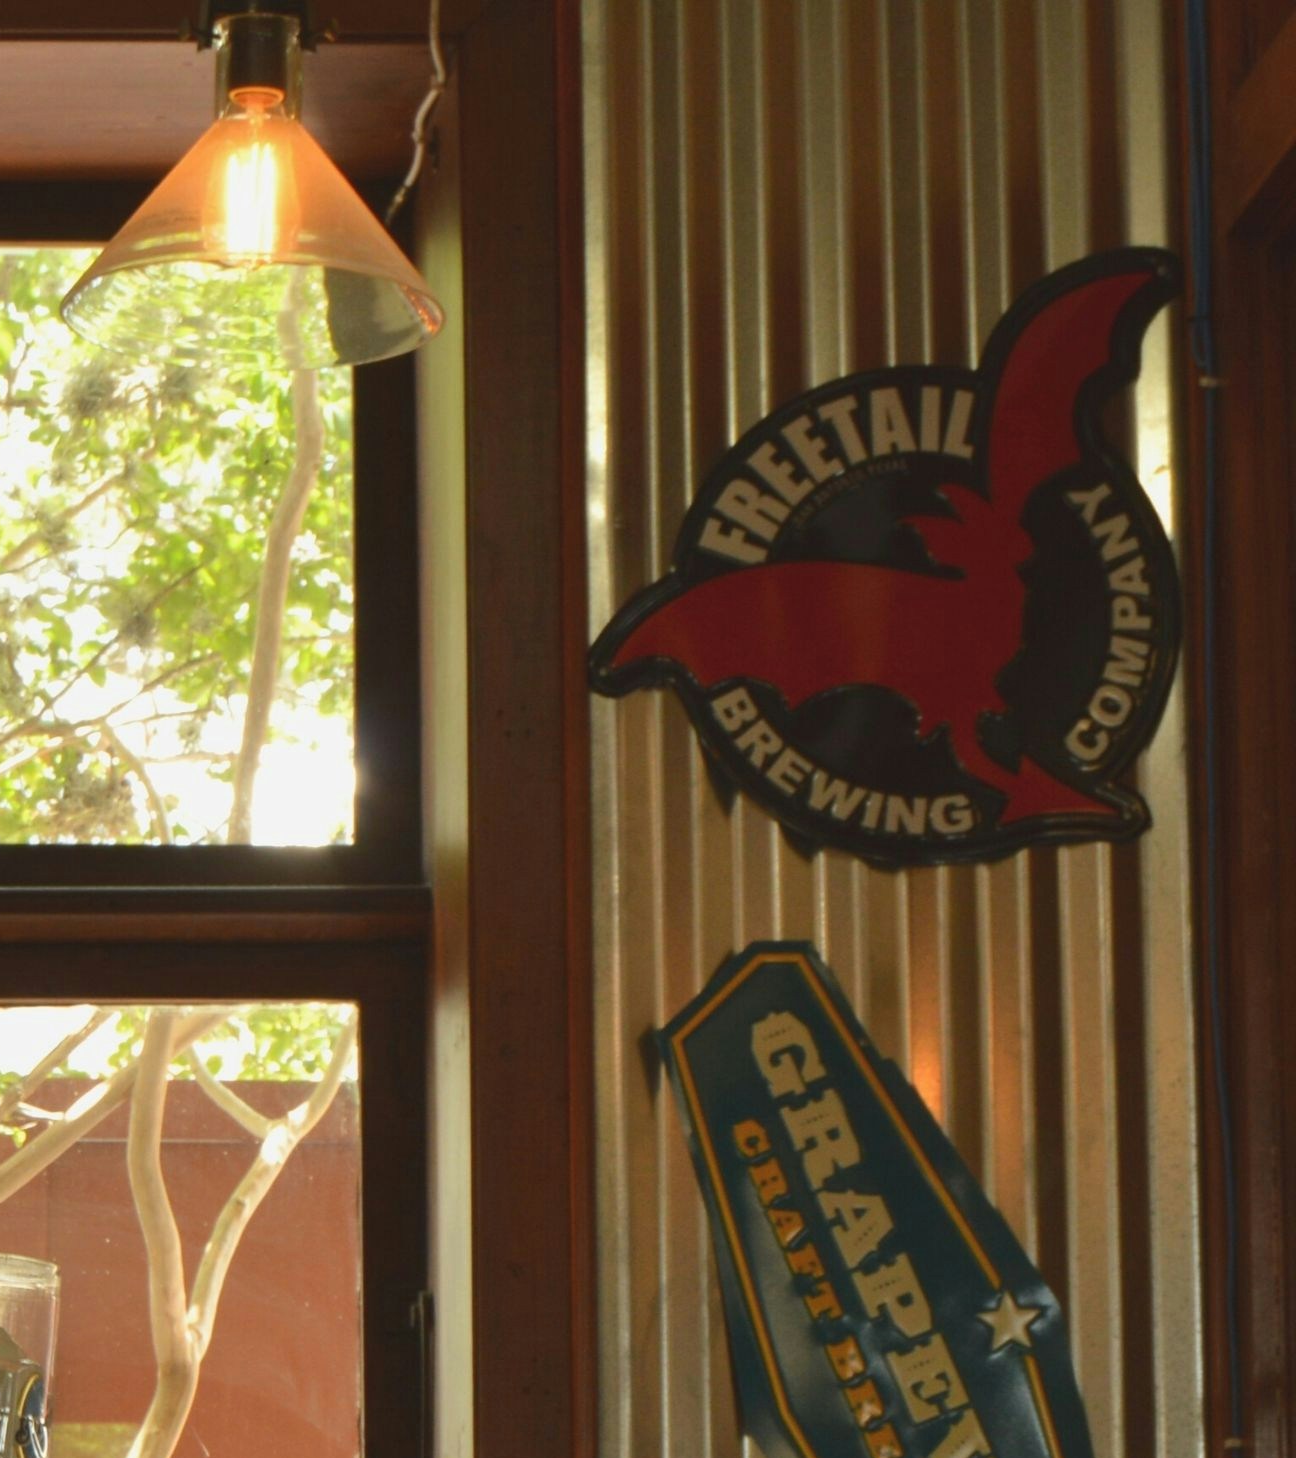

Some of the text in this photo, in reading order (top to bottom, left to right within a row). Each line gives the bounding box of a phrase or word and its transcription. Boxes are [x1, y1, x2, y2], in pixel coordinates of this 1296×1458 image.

[698, 386, 976, 565] FREETAIL
[1063, 482, 1152, 764] COMPANY
[711, 685, 975, 836] BREWING
[732, 1117, 845, 1321] CRAFT
